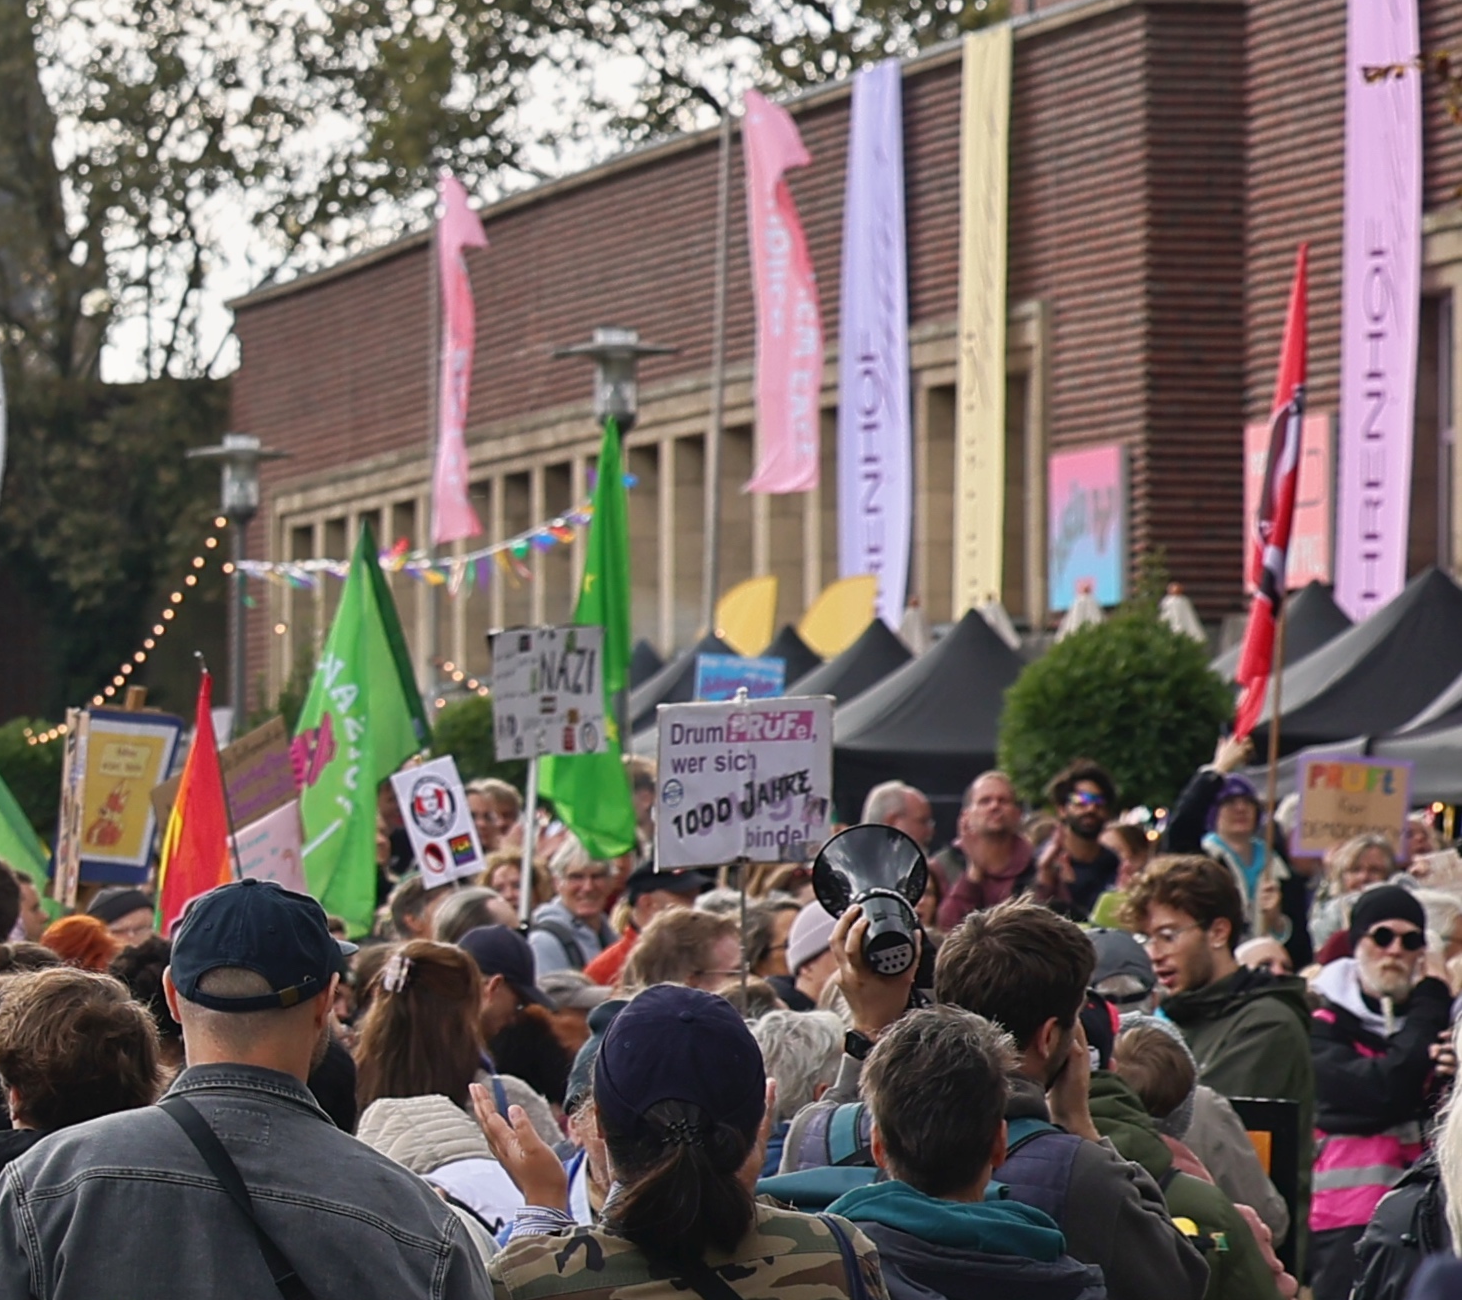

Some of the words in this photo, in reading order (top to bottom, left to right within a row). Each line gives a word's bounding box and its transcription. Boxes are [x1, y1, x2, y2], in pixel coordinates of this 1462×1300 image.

[537, 648, 596, 696] NAZI
[670, 722, 724, 746] Drum
[671, 755, 707, 774] wer
[714, 749, 757, 772] sich
[671, 796, 732, 839] 1000
[739, 767, 813, 820] JAHRE
